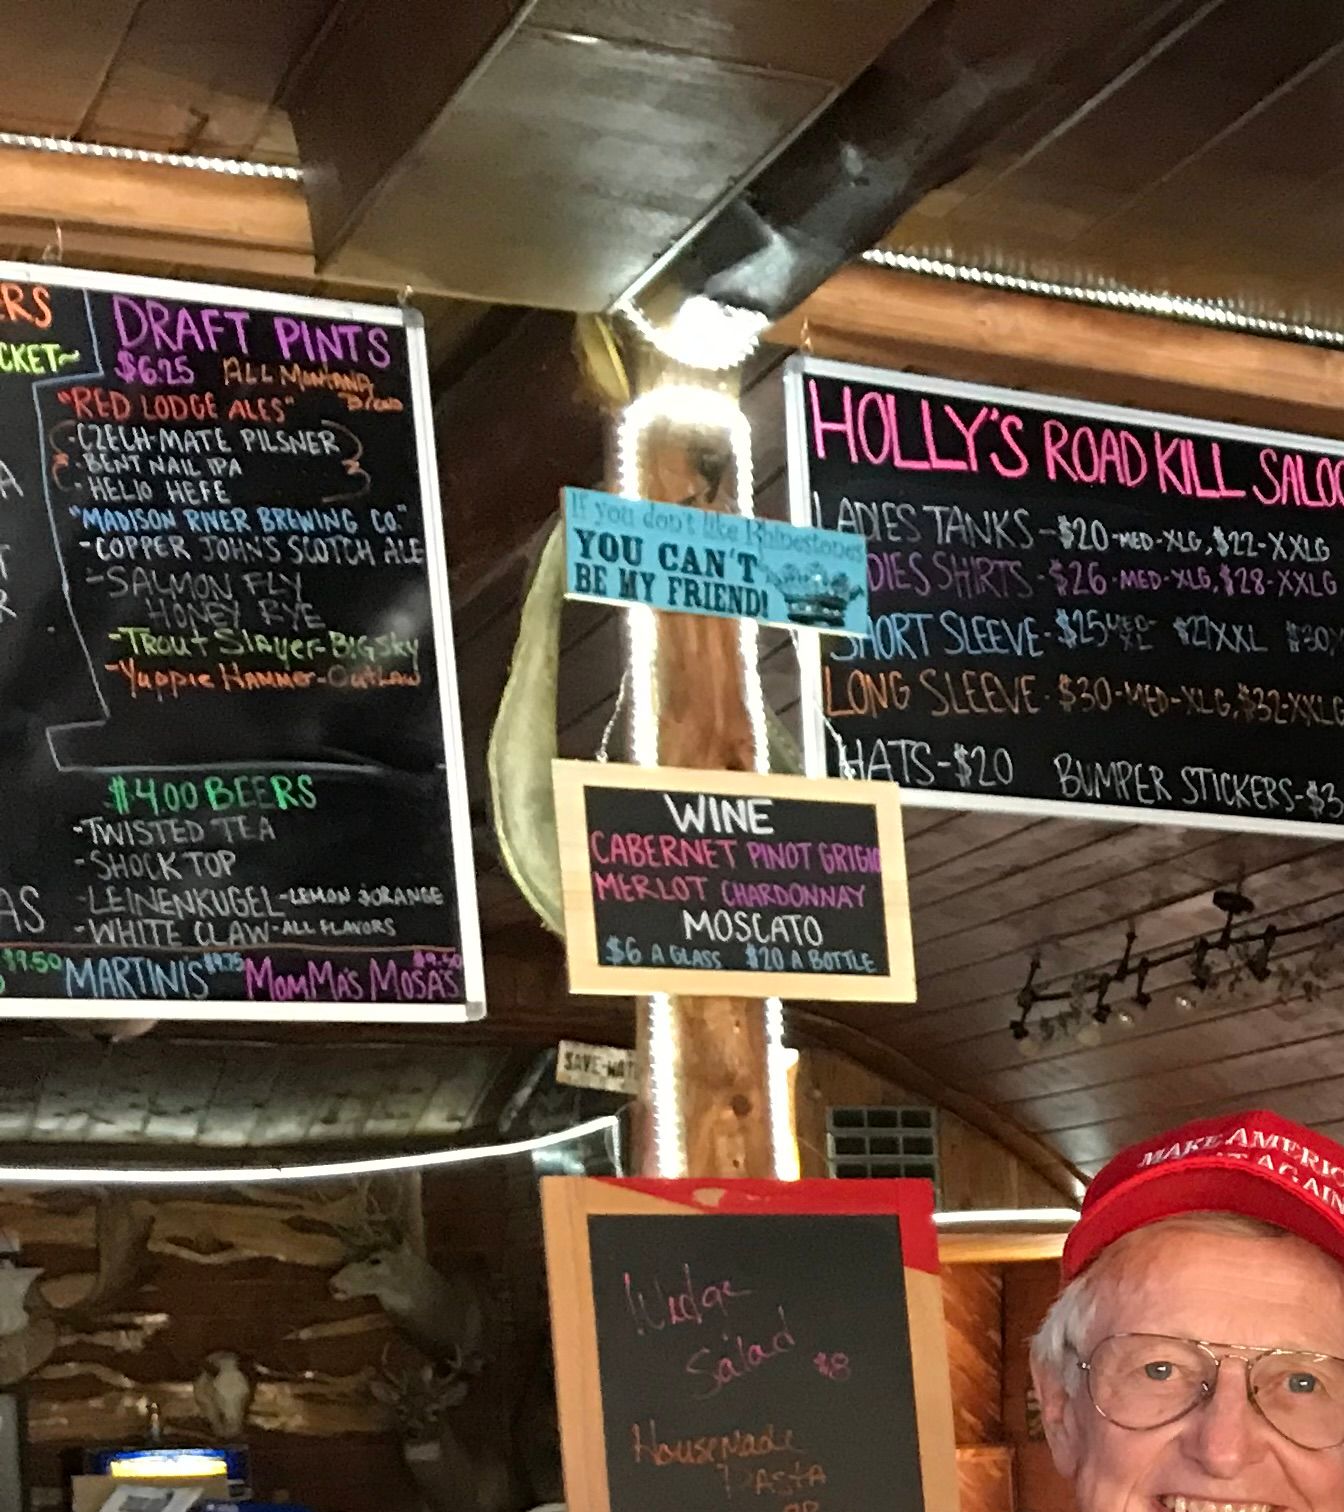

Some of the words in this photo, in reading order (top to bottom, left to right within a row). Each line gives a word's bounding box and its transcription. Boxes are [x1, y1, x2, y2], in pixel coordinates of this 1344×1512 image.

[112, 294, 250, 355] DRAFT
[273, 316, 391, 368] PINTS
[223, 356, 273, 386] ALL
[141, 389, 217, 420] LODGE
[241, 426, 340, 456] PILSNER
[808, 379, 1030, 478] HOLLY'S
[1043, 419, 1148, 488] ROAD
[1154, 431, 1247, 498] KILL
[149, 457, 202, 478] NAIL
[208, 458, 243, 478] IPA
[167, 480, 232, 505] HEFE
[185, 507, 249, 533] RIVER
[259, 507, 358, 534] BREWING
[594, 501, 634, 527] you
[922, 504, 1034, 550] TANKS
[287, 539, 376, 567] SCOTCH
[384, 538, 425, 566] ALE
[573, 527, 644, 566] YOU
[658, 541, 758, 584] CAN'T
[246, 571, 303, 600] FLY
[574, 562, 607, 597] BE
[618, 567, 656, 602] MY
[668, 576, 769, 619] FRIEND!
[866, 552, 932, 597] DIES
[932, 551, 1034, 600] SHIRTS
[147, 597, 241, 631] HONEY
[259, 599, 327, 631] RYE
[823, 664, 912, 719] LONG
[919, 669, 1041, 717] SLEEVE
[205, 776, 317, 812] BEERS
[1053, 752, 1172, 805] BUMPER
[211, 816, 276, 844] TEA
[663, 792, 775, 836] WINE
[187, 851, 237, 880] TOP
[590, 830, 740, 869] CABERNET
[746, 840, 812, 870] PINOT
[818, 841, 881, 875] GRIGIO
[593, 871, 708, 902] MERLOT
[720, 881, 867, 910] CHARDONNAY
[194, 919, 270, 947] CLAW
[320, 917, 397, 937] FLAVORS
[682, 909, 824, 947] MOSCATO
[605, 934, 642, 966] $6
[651, 944, 665, 964] A
[669, 945, 722, 969] GLASS
[745, 942, 784, 971] $20
[790, 949, 804, 970] A
[809, 948, 877, 972] BOTTLE
[1137, 1132, 1223, 1169] MAKE
